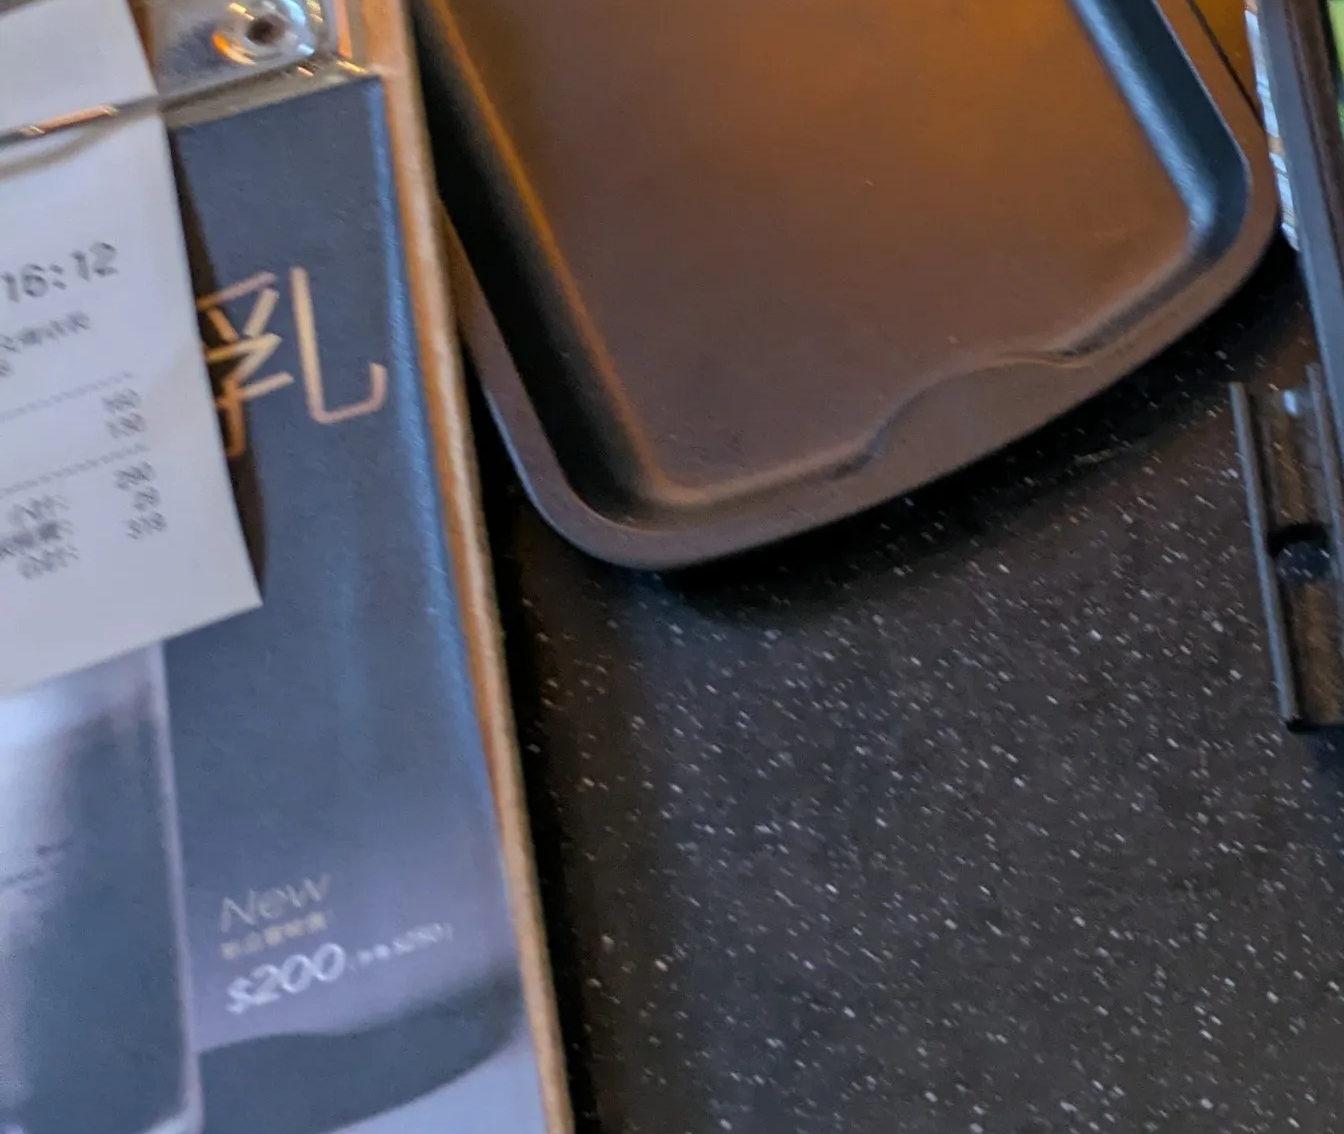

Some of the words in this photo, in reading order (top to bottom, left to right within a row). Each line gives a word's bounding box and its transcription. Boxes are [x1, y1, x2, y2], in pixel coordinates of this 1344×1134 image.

[0, 242, 118, 303] 16:12
[220, 873, 332, 934] New
[226, 941, 347, 1016] $200
